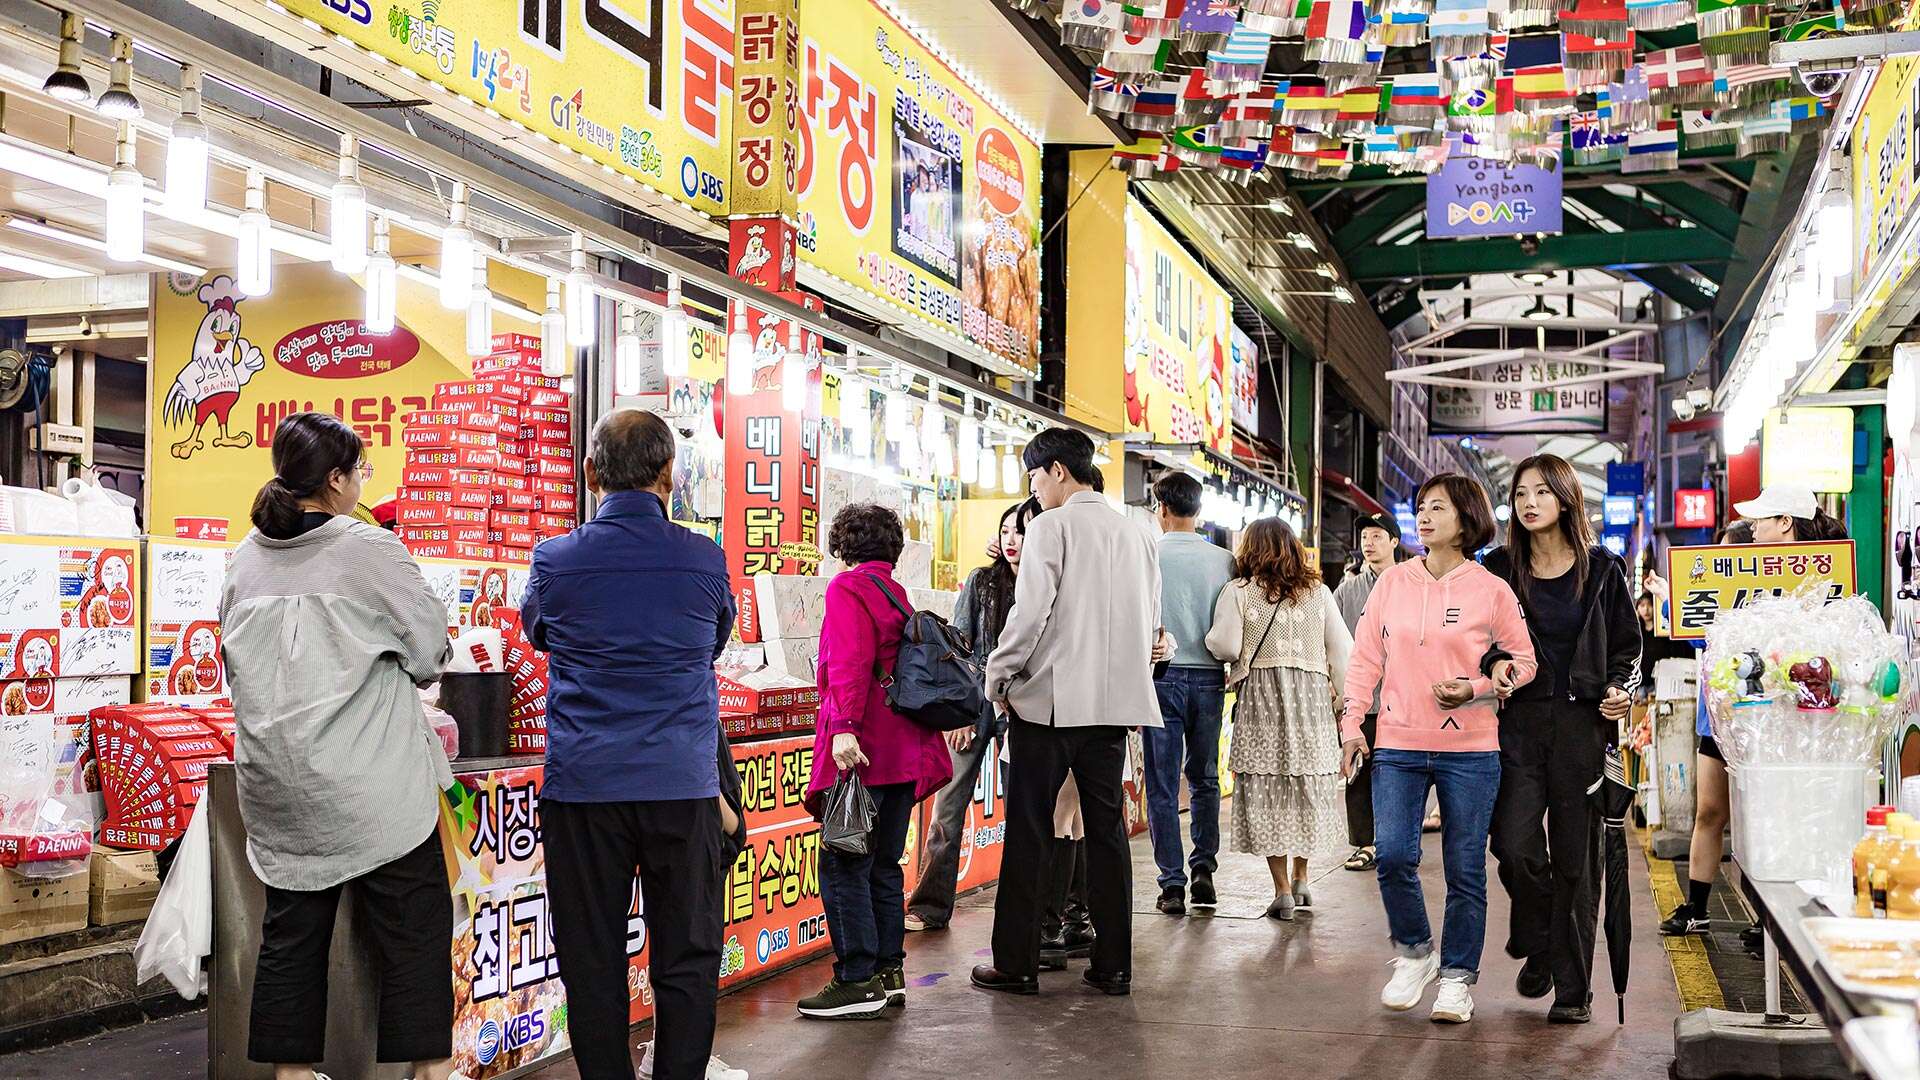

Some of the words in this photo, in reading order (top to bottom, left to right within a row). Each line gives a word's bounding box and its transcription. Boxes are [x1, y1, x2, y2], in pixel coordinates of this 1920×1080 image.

[739, 15, 779, 187] 닭강정
[576, 114, 616, 152] 강원민방
[701, 171, 724, 203] SBS
[1456, 182, 1534, 200] Yangban
[868, 252, 916, 306] 배니강정은
[919, 280, 961, 330] 금성닭집의
[1155, 249, 1192, 352] 배니
[306, 352, 329, 372] 맛도
[360, 360, 376, 371] 전국
[524, 376, 560, 388] 배니닭강정
[449, 383, 493, 395] 배니닭강정
[1495, 390, 1523, 411] 방문
[1560, 390, 1603, 410] 합니다
[442, 402, 476, 411] BAENNI
[420, 415, 458, 424] 배니닭강정
[533, 411, 567, 423] 배니닭강정
[410, 433, 440, 442] BAENNI
[543, 429, 567, 438] BAENNI
[541, 446, 571, 457] 배니닭강정
[419, 453, 456, 464] 배니닭강정
[467, 453, 494, 464] BAENNI
[546, 464, 571, 474] BAENNI
[409, 472, 442, 482] BAENNI
[460, 473, 489, 484] 배니닭강정
[543, 482, 574, 493] 배니닭강정
[411, 491, 451, 501] 배니닭강정
[461, 493, 487, 504] BAENNI
[512, 495, 532, 505] BAENNI
[551, 500, 573, 509] BAENNI
[403, 509, 435, 519] BAENNI
[453, 510, 485, 522] 배니닭강정
[501, 514, 528, 525] 배니닭강정
[408, 530, 448, 540] 배니닭강정
[459, 530, 484, 539] BAENNI
[511, 533, 532, 542] BAENNI
[413, 546, 447, 556] BAENNI
[1713, 554, 1832, 577] 배니닭강정
[742, 587, 752, 633] BAENNI
[767, 694, 792, 707] 배니닭강정
[756, 716, 782, 729] 배니닭강정
[792, 714, 814, 725] 배니닭강정
[173, 740, 214, 752] BAENNI
[472, 785, 538, 861] 시장
[106, 829, 160, 846] 배니닭강정
[37, 837, 82, 854] BAENNI
[798, 913, 826, 946] MBC
[772, 927, 789, 952] SBS
[503, 1008, 545, 1053] KBS
